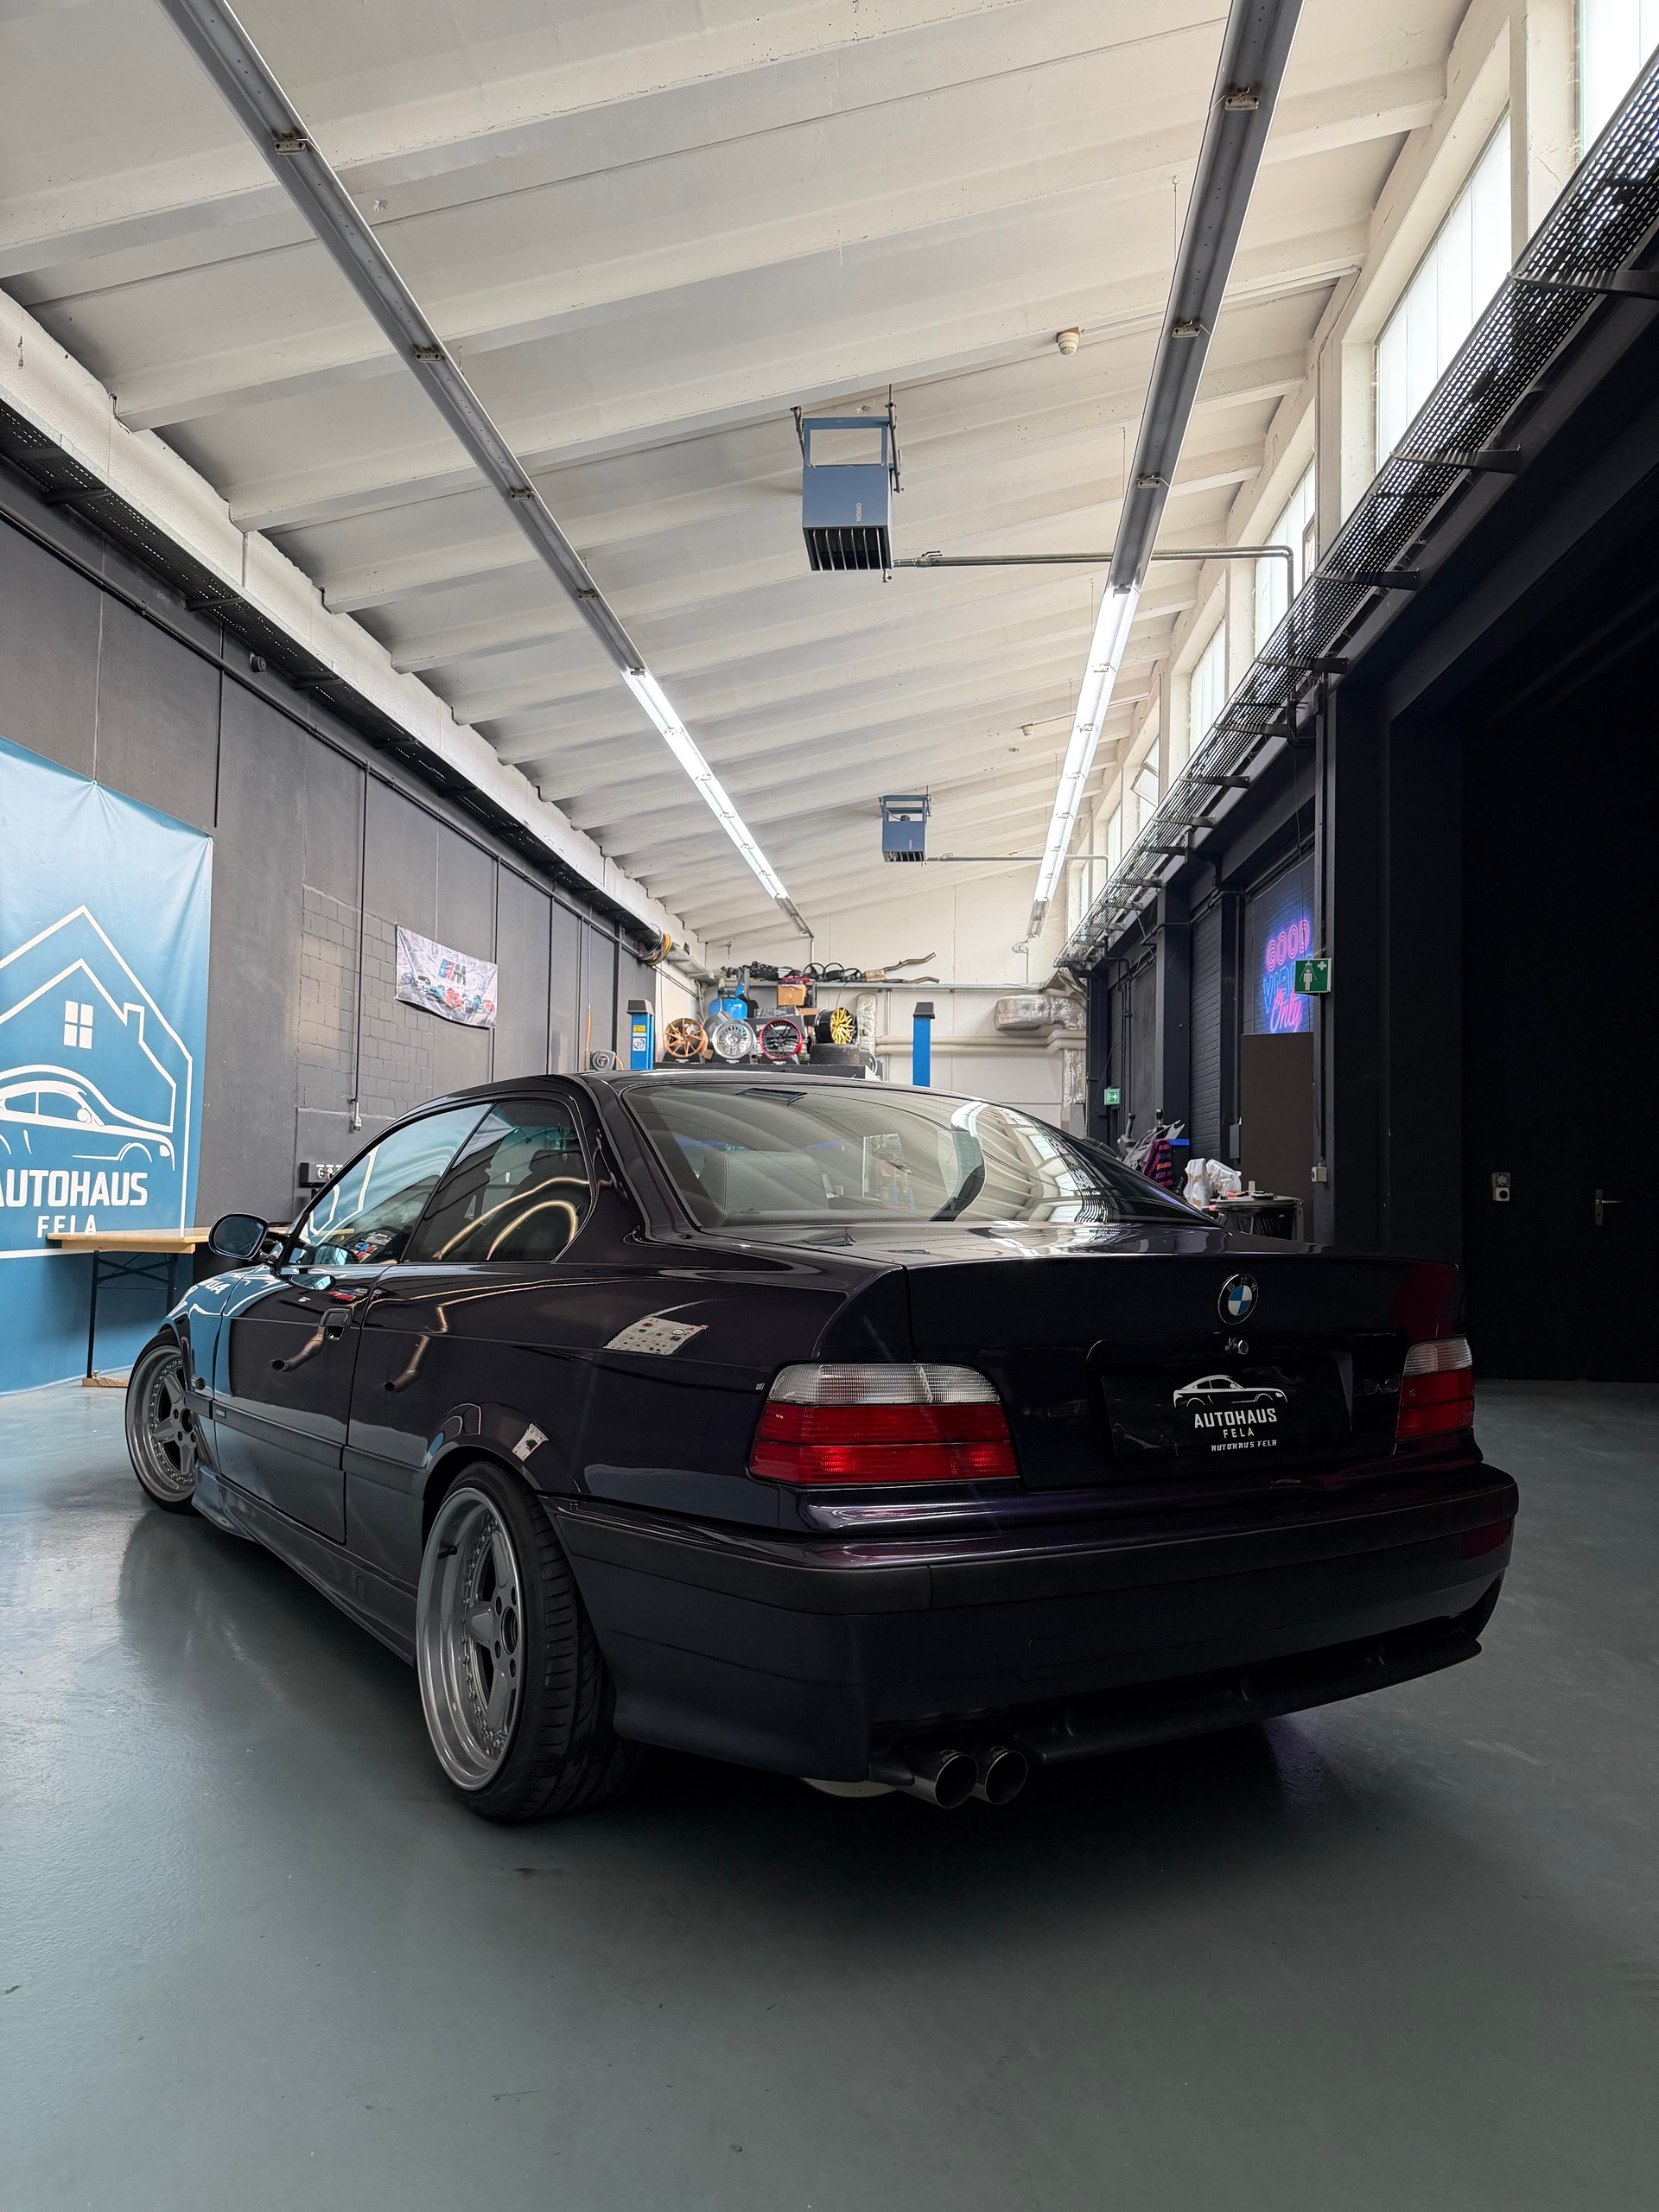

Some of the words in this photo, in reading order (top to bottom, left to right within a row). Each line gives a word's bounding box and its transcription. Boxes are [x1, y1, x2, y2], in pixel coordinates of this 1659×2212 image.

[1267, 919, 1310, 971] GOOD
[1270, 985, 1302, 1033] Only
[0, 1169, 148, 1207] UTOHAUS
[1194, 1408, 1277, 1428] AUTOHAUS
[1211, 1441, 1255, 1452] AUTOHAUS
[1257, 1440, 1277, 1448] FELA
[1223, 1427, 1255, 1439] FELA
